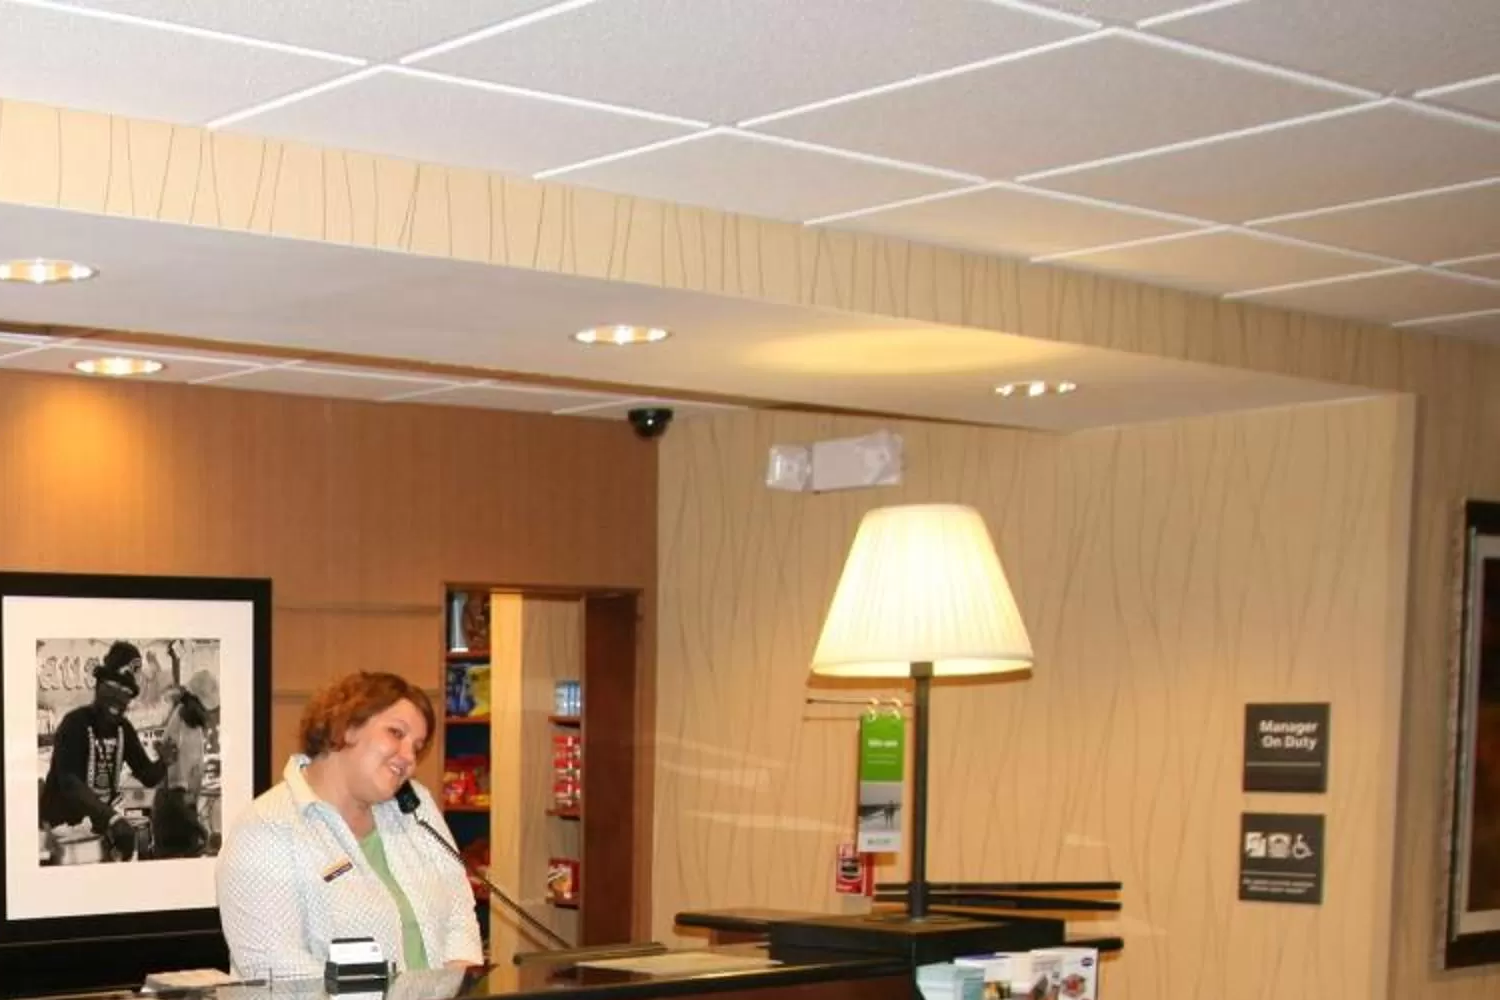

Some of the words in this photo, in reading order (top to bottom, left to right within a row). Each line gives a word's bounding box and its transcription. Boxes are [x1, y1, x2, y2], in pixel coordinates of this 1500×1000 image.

[1259, 719, 1319, 736] Manager
[1262, 735, 1282, 749] On
[1285, 735, 1318, 751] Duty
